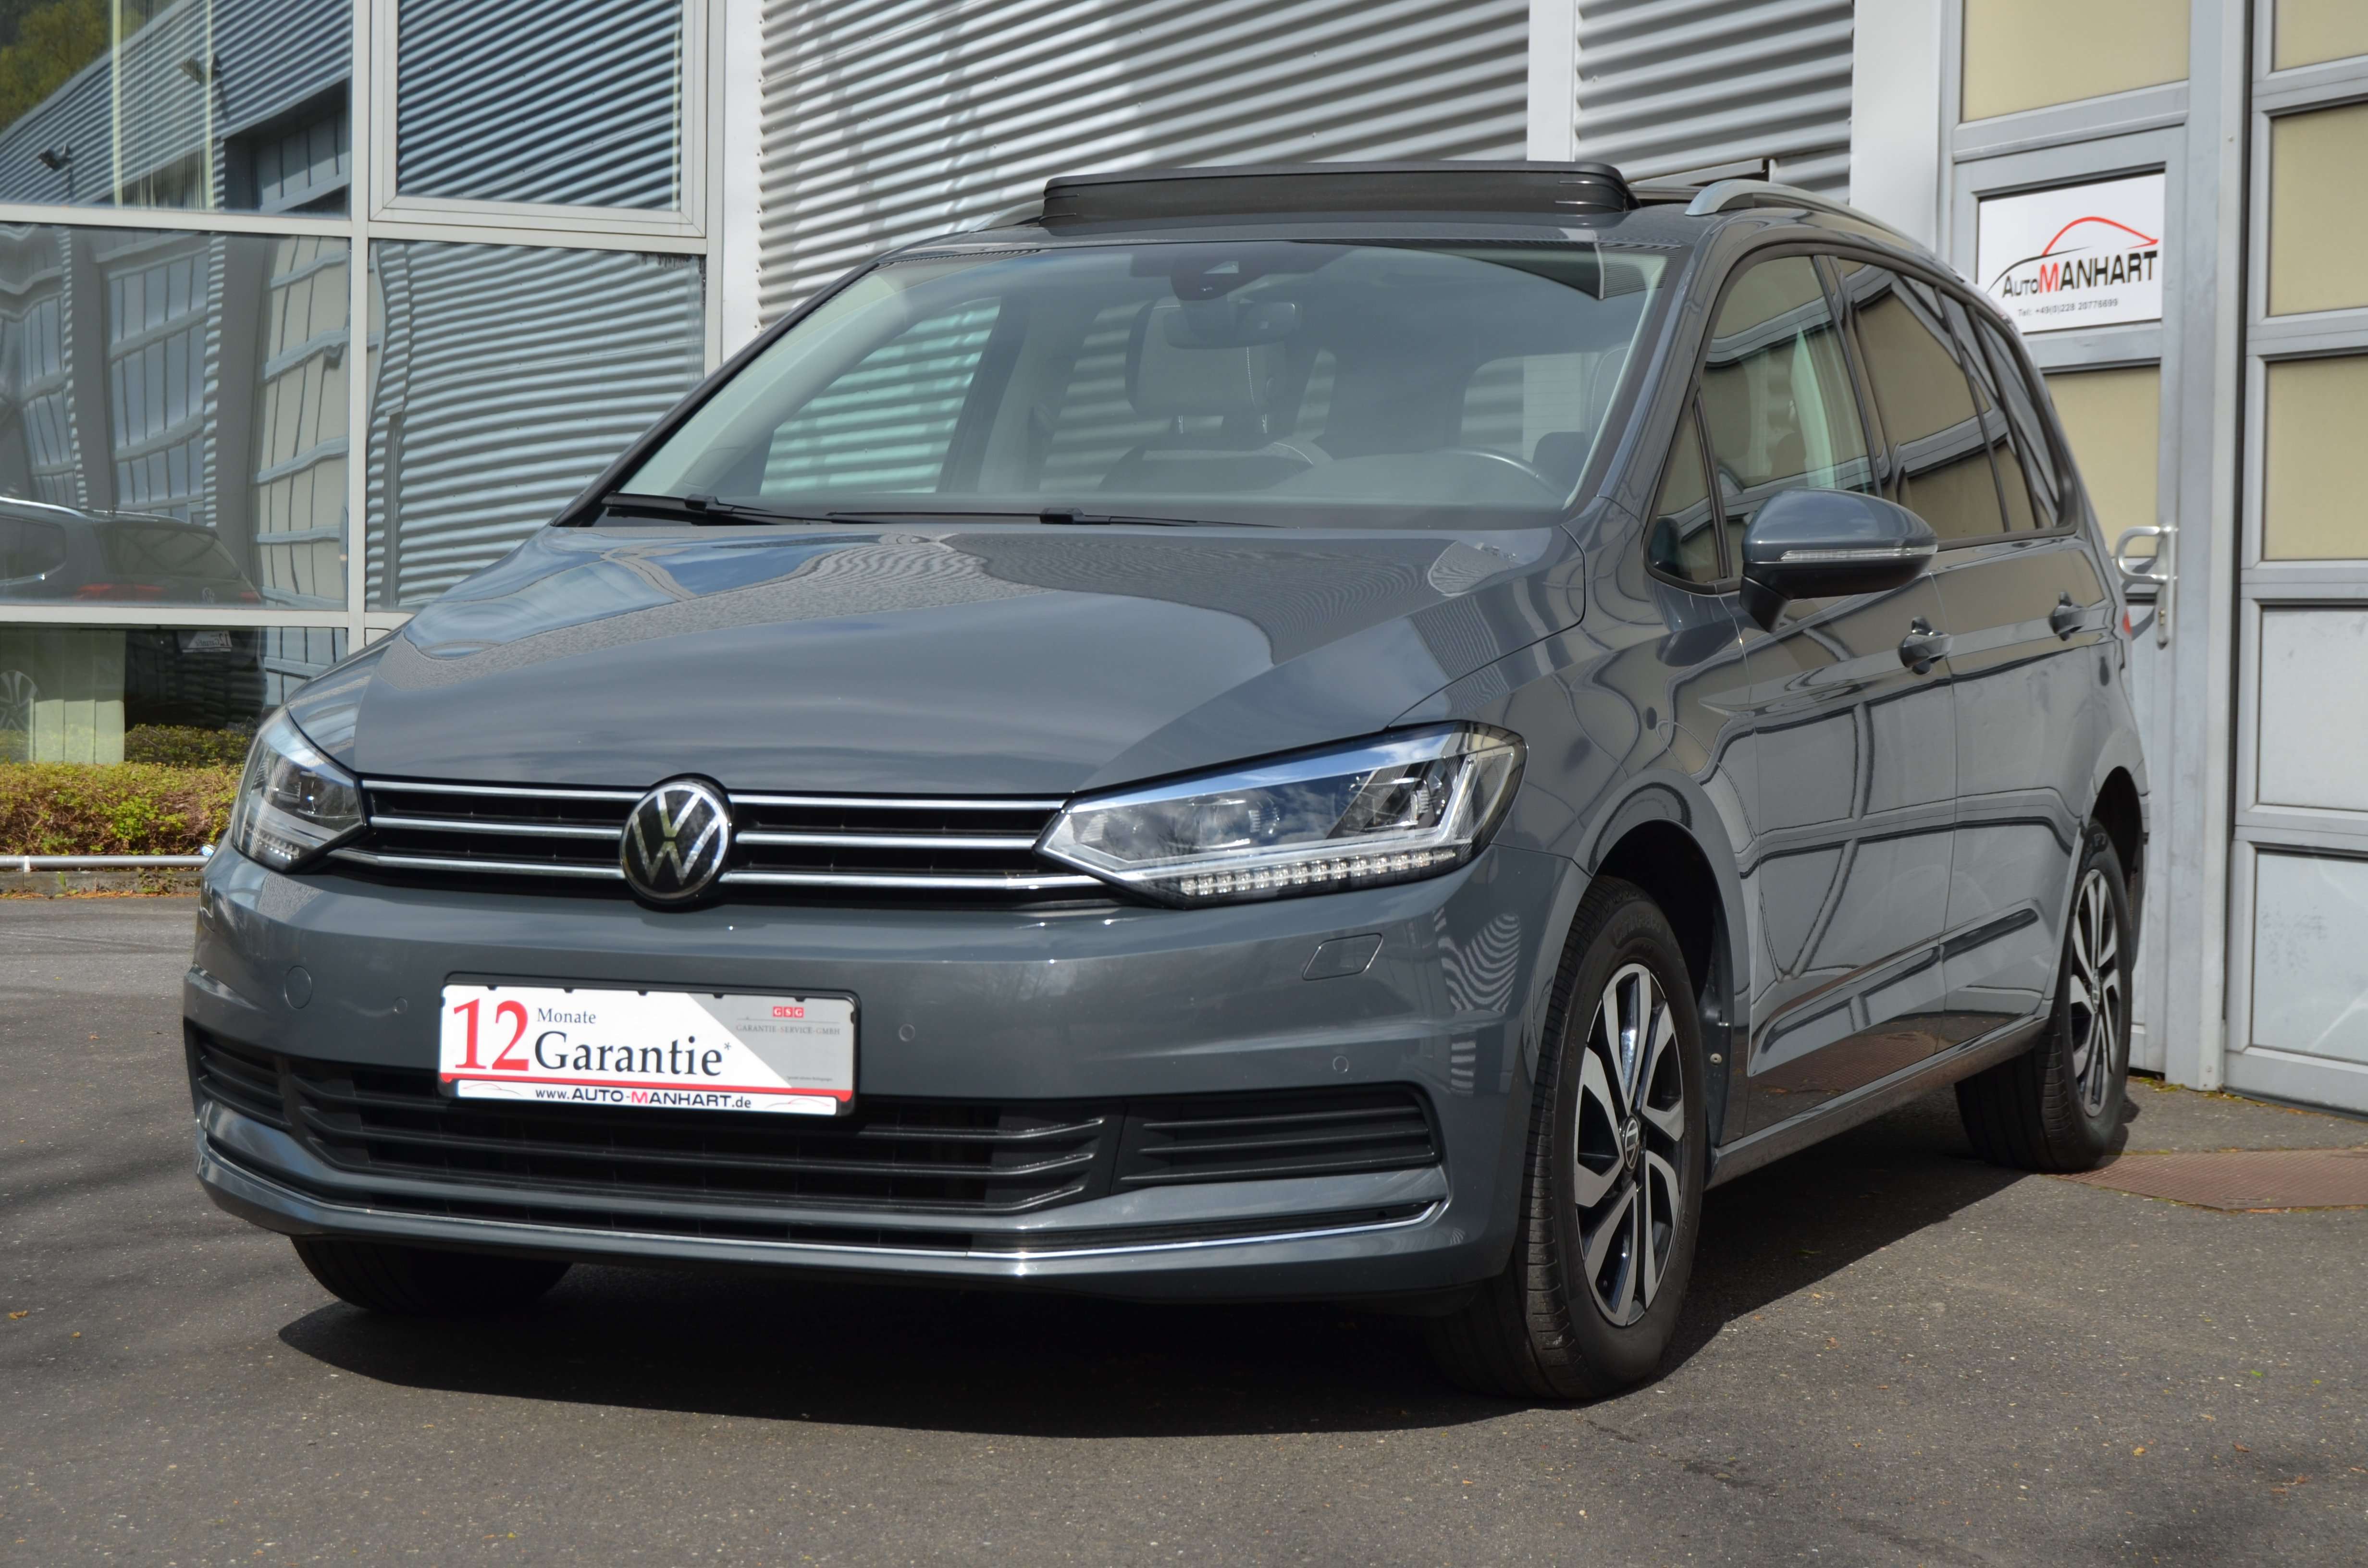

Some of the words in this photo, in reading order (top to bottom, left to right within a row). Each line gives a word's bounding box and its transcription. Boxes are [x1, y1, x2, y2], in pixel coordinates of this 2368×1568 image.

[537, 1008, 596, 1024] Monate
[773, 1007, 804, 1017] GSG
[453, 998, 530, 1072] 12
[535, 1088, 752, 1108] www.AUTO-MANHART.de
